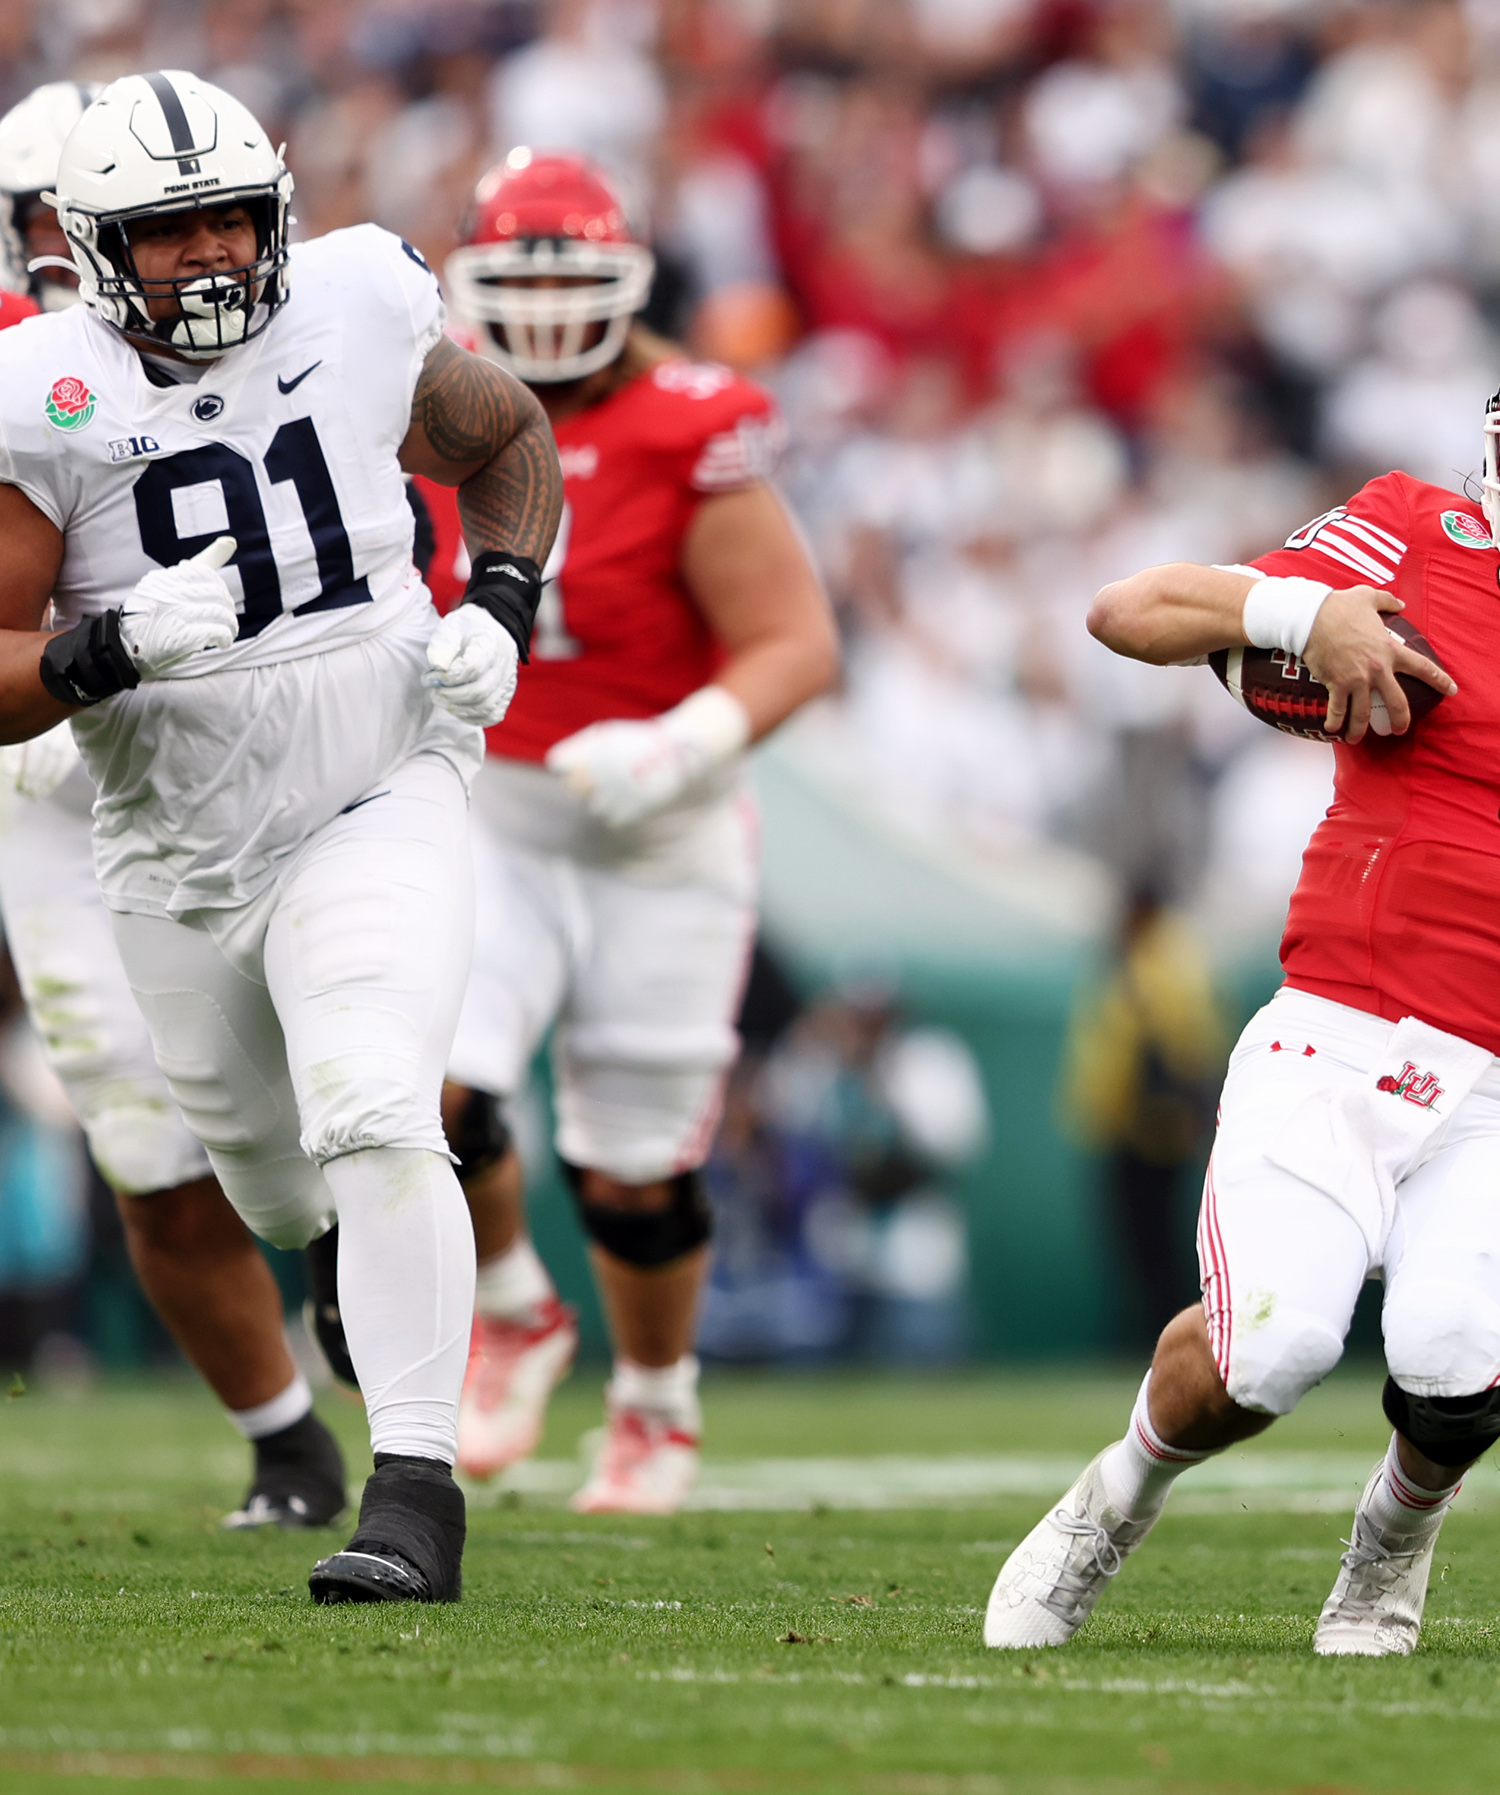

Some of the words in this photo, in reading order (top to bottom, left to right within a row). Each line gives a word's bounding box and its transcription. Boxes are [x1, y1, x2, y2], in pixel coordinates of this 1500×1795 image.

[164, 183, 189, 194] PENN
[192, 178, 220, 189] STATE
[132, 415, 374, 642] 91
